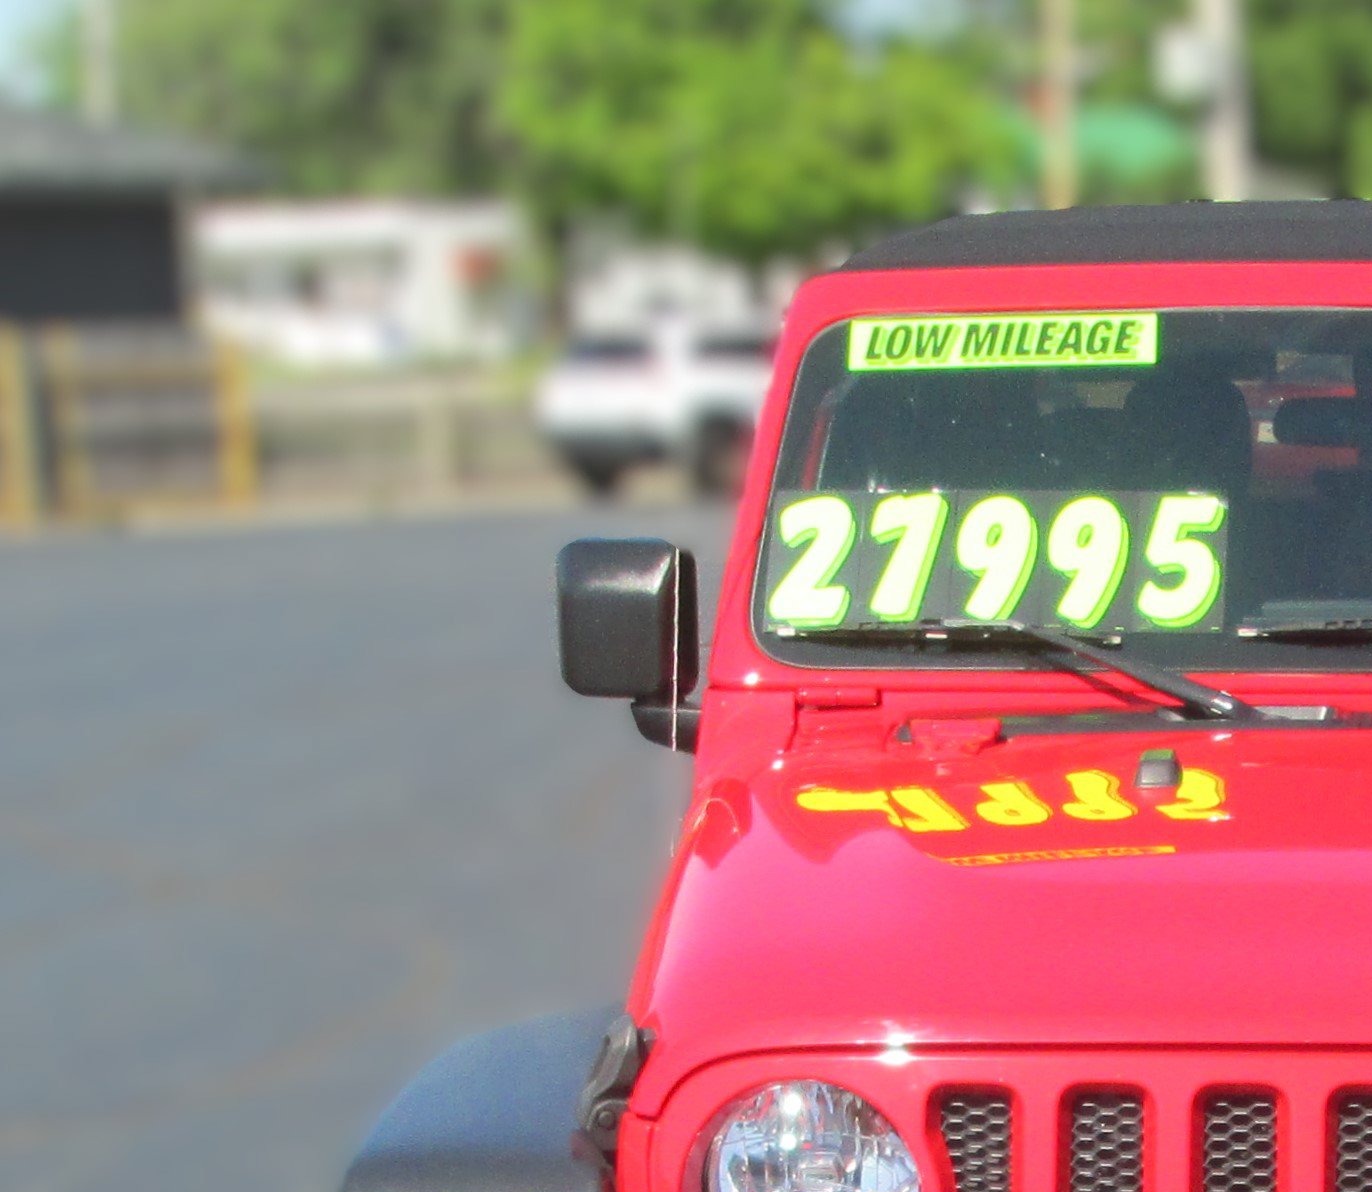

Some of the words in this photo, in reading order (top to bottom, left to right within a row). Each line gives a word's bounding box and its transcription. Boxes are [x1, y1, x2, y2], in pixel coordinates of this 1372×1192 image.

[865, 322, 952, 361] LOW
[959, 319, 1140, 358] MILEAGE
[768, 492, 1226, 630] 27995
